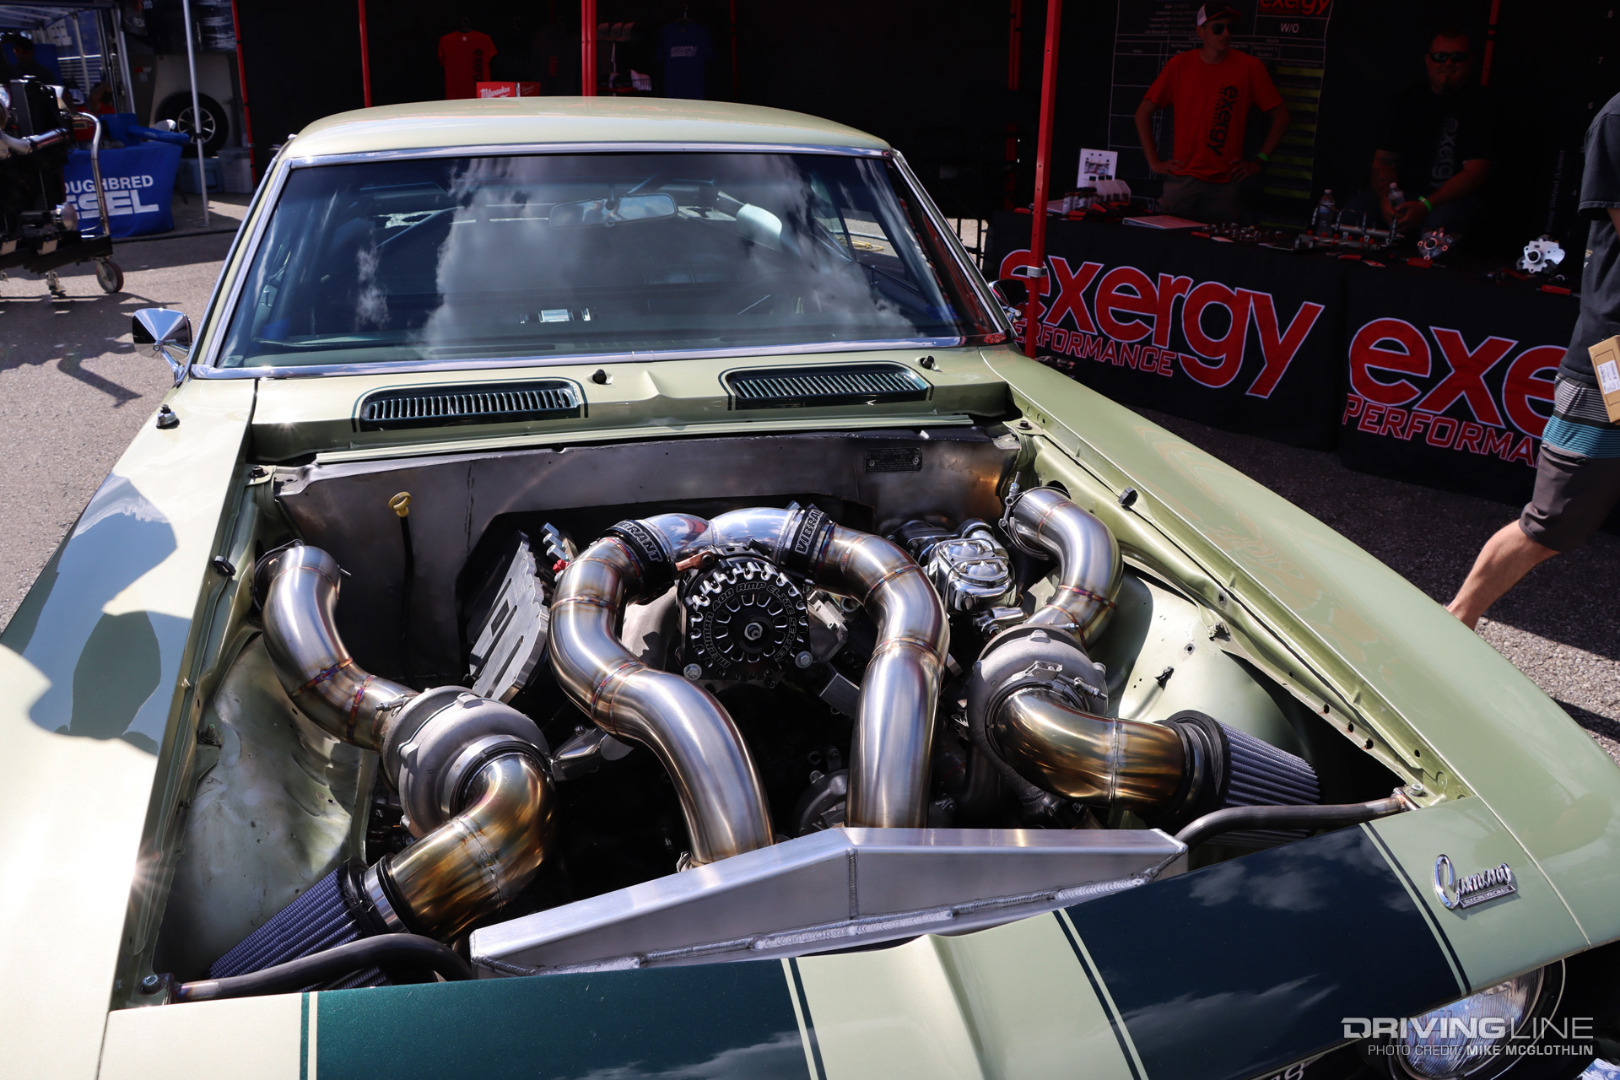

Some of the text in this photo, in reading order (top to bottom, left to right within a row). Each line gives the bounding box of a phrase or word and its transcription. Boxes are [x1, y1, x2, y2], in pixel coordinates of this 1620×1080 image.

[1280, 22, 1300, 34] W/O
[1207, 86, 1239, 156] exergy
[1342, 392, 1541, 469] PERFORMA
[795, 509, 825, 555] VIBRA
[712, 588, 735, 612] 400
[736, 581, 767, 593] AMP
[766, 585, 796, 615] ELITE
[773, 616, 798, 663] SERIES
